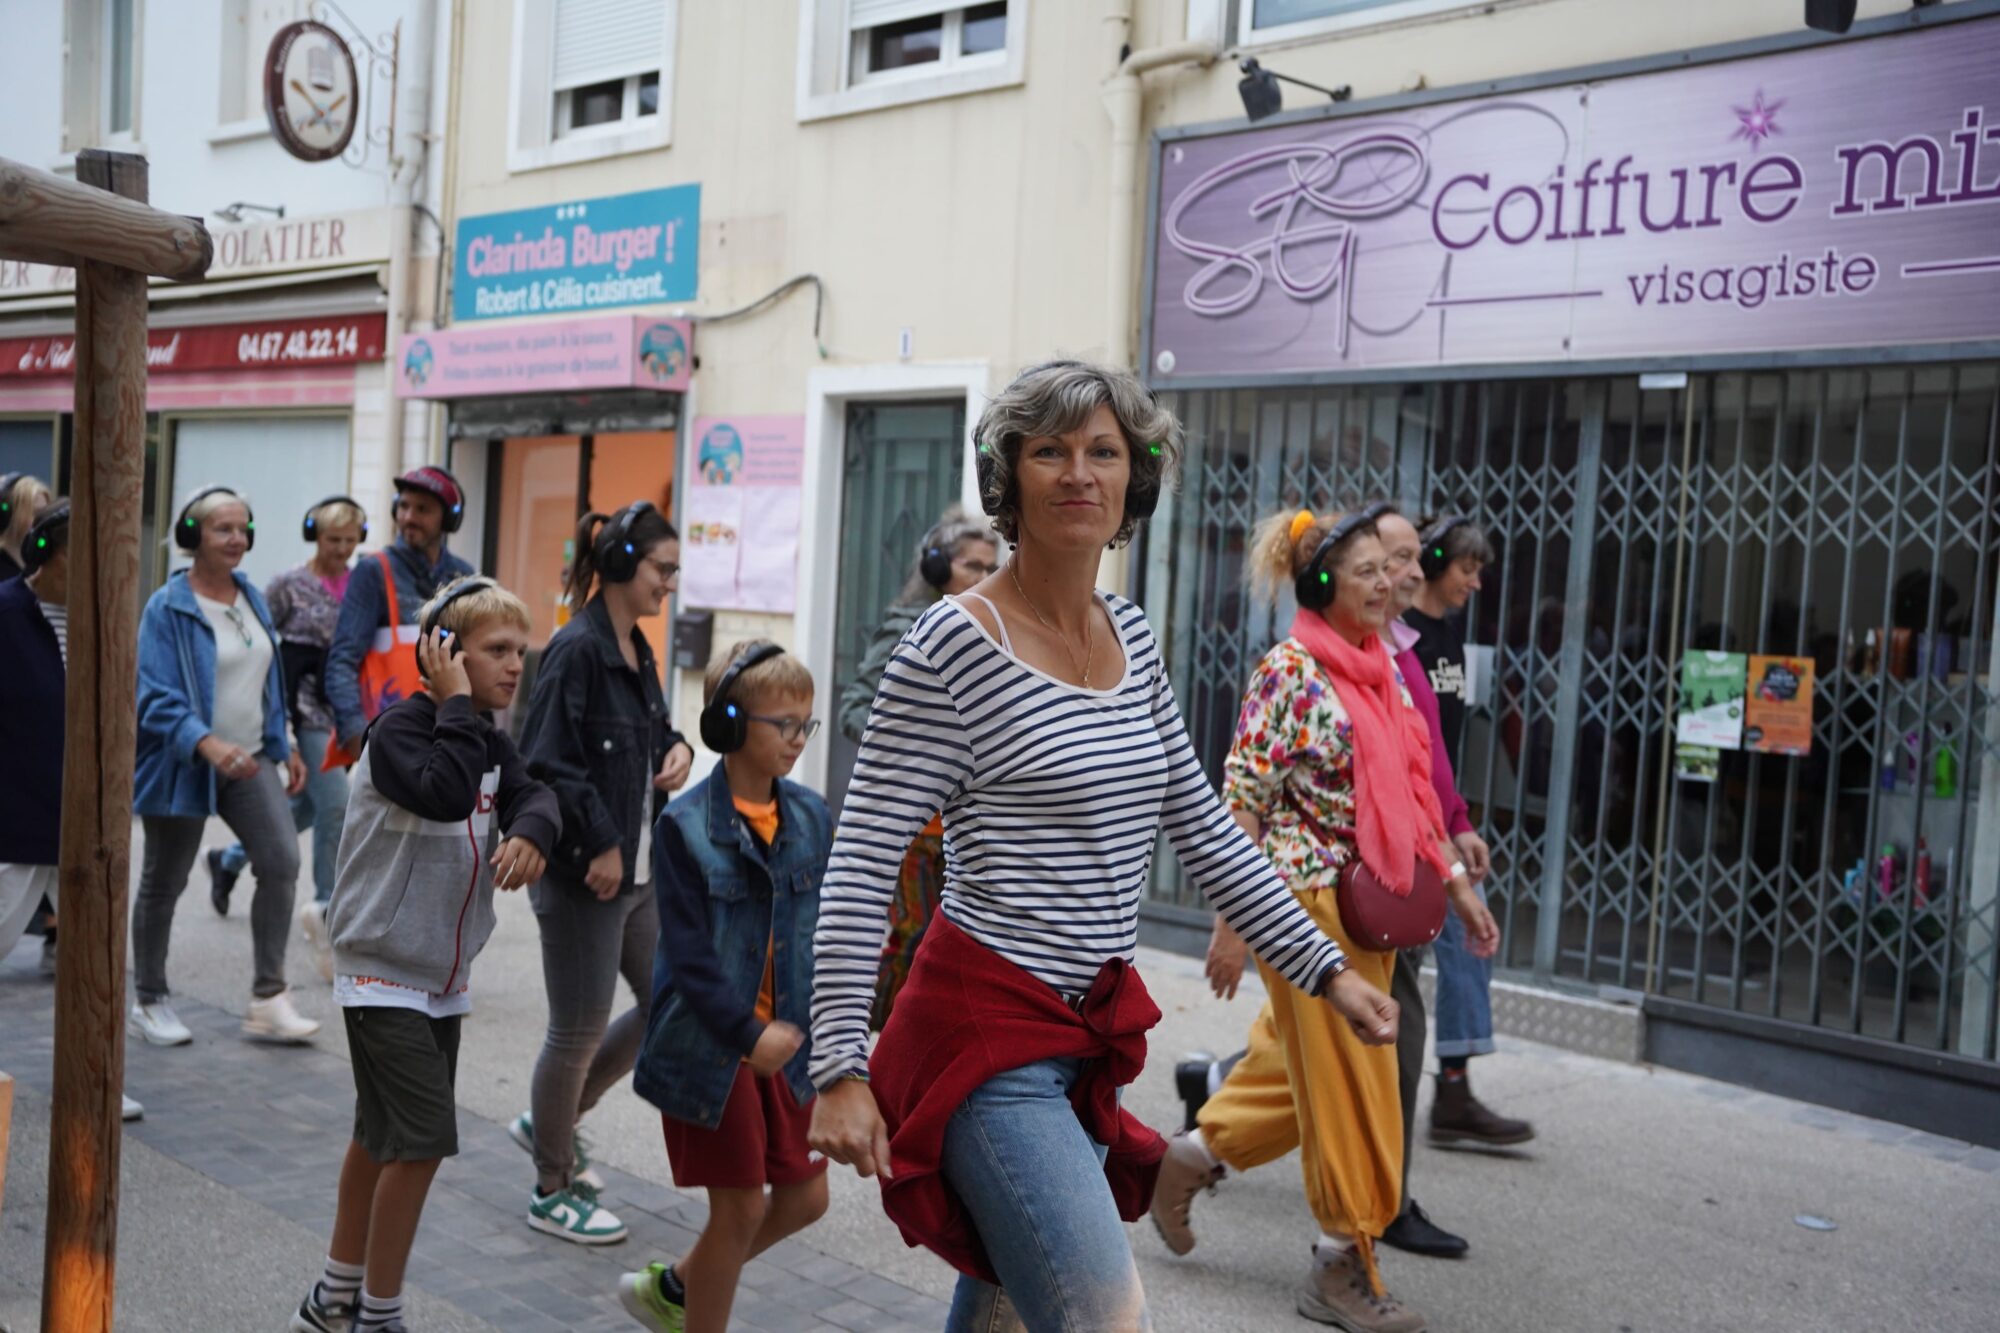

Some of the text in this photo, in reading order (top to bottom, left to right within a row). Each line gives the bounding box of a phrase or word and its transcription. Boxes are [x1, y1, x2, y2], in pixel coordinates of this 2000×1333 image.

[1432, 155, 1803, 250] Coiffure
[466, 226, 567, 278] Clarinda
[572, 223, 663, 272] Burger
[475, 271, 668, 316] Robert & Célia cuisinent.
[1628, 251, 1877, 308] visagiste
